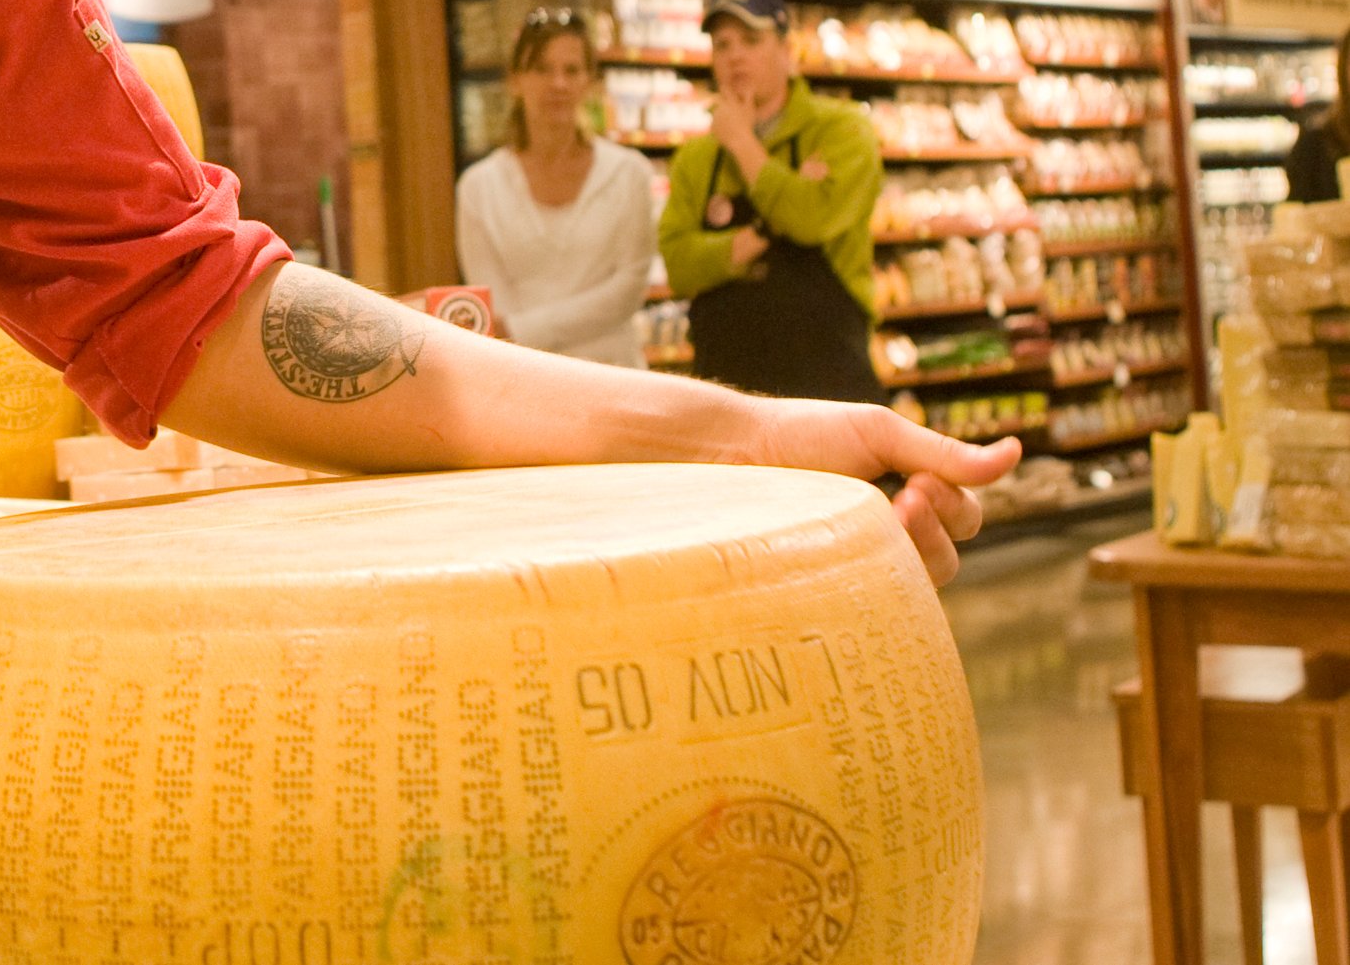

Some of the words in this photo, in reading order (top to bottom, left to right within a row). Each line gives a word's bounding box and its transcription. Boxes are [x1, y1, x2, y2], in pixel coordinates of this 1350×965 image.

[306, 375, 366, 398] THE
[576, 661, 652, 736] 05
[687, 644, 792, 722] NOV
